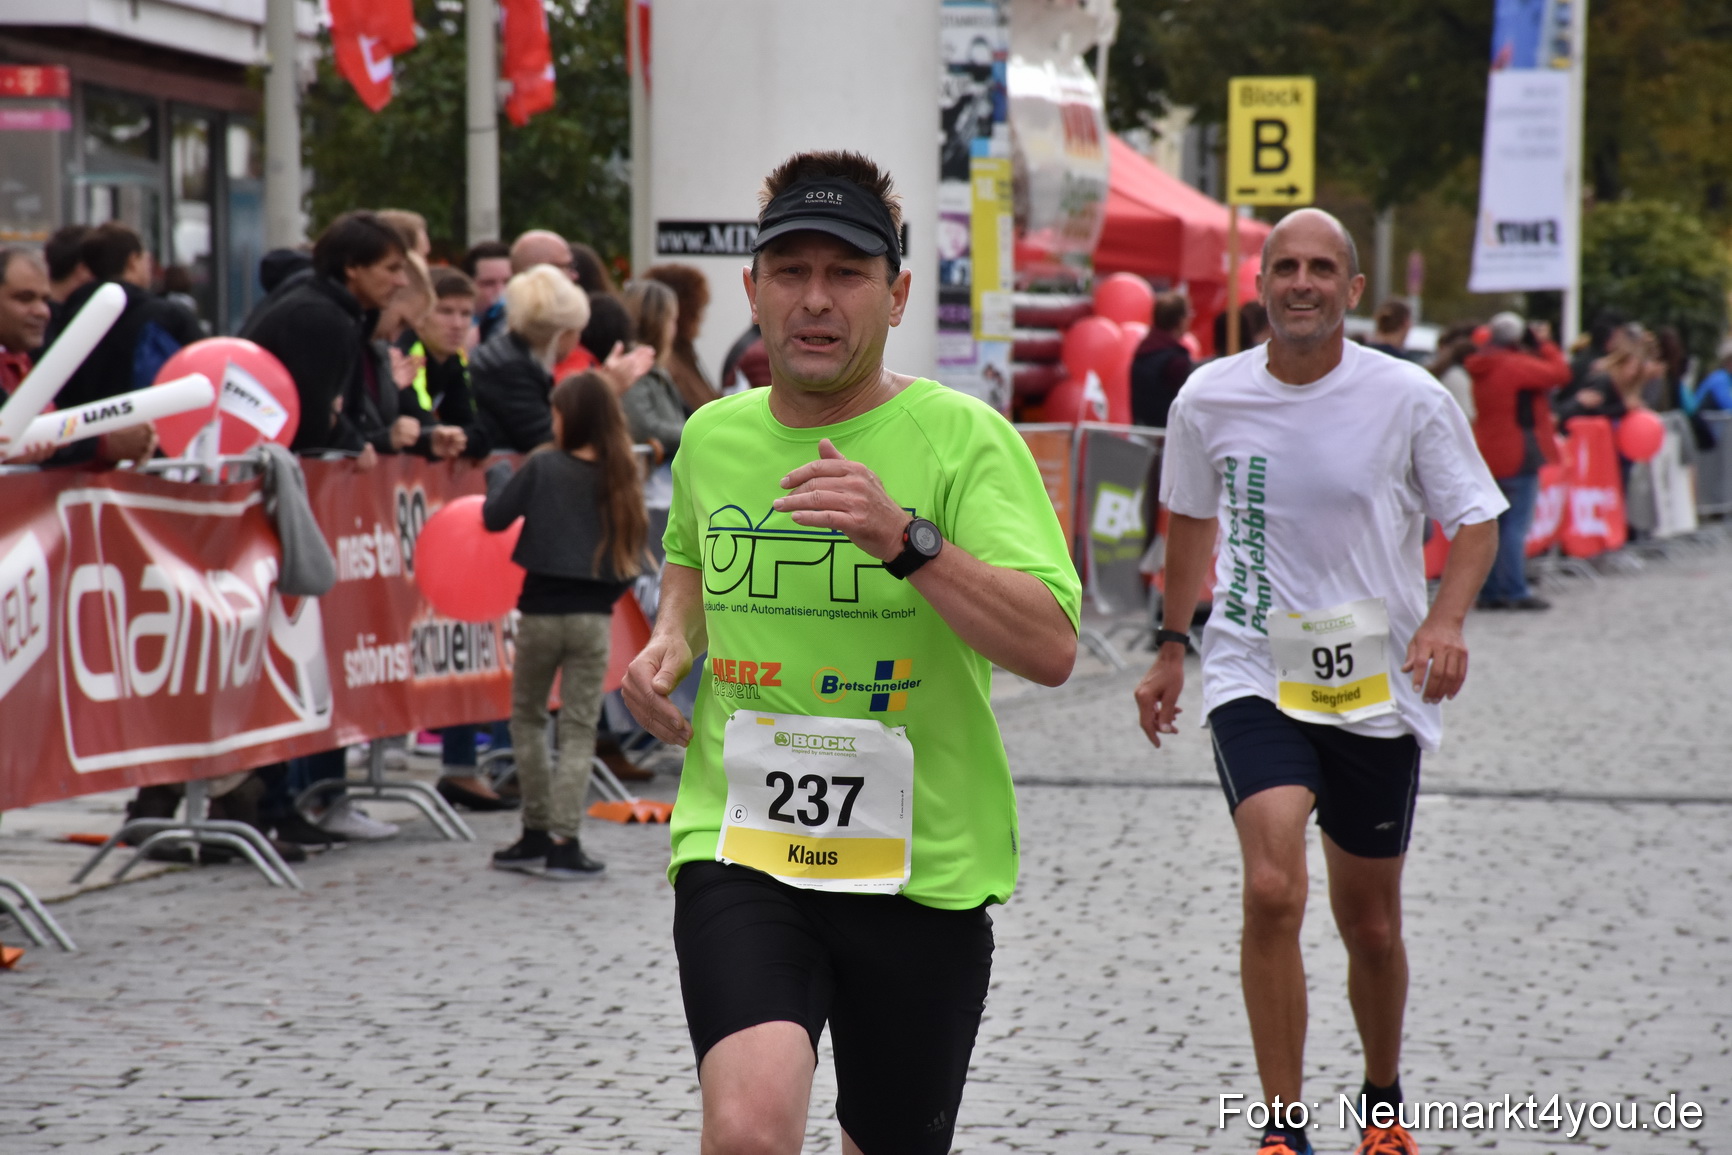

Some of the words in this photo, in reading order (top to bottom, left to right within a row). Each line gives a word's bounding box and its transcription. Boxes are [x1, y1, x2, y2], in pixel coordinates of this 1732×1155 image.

[1239, 87, 1301, 107] Block
[1253, 119, 1289, 173] B
[806, 191, 843, 201] GORE
[731, 603, 748, 613] und
[751, 604, 878, 620] Automatisierungstechnik
[881, 607, 916, 619] GmbH
[1312, 642, 1354, 680] 95
[712, 658, 782, 687] MERZ
[821, 675, 922, 694] Bretschneider
[1311, 686, 1361, 707] Siegfried
[792, 733, 856, 752] BOCK
[766, 771, 864, 827] 237
[787, 843, 838, 866] Klaus
